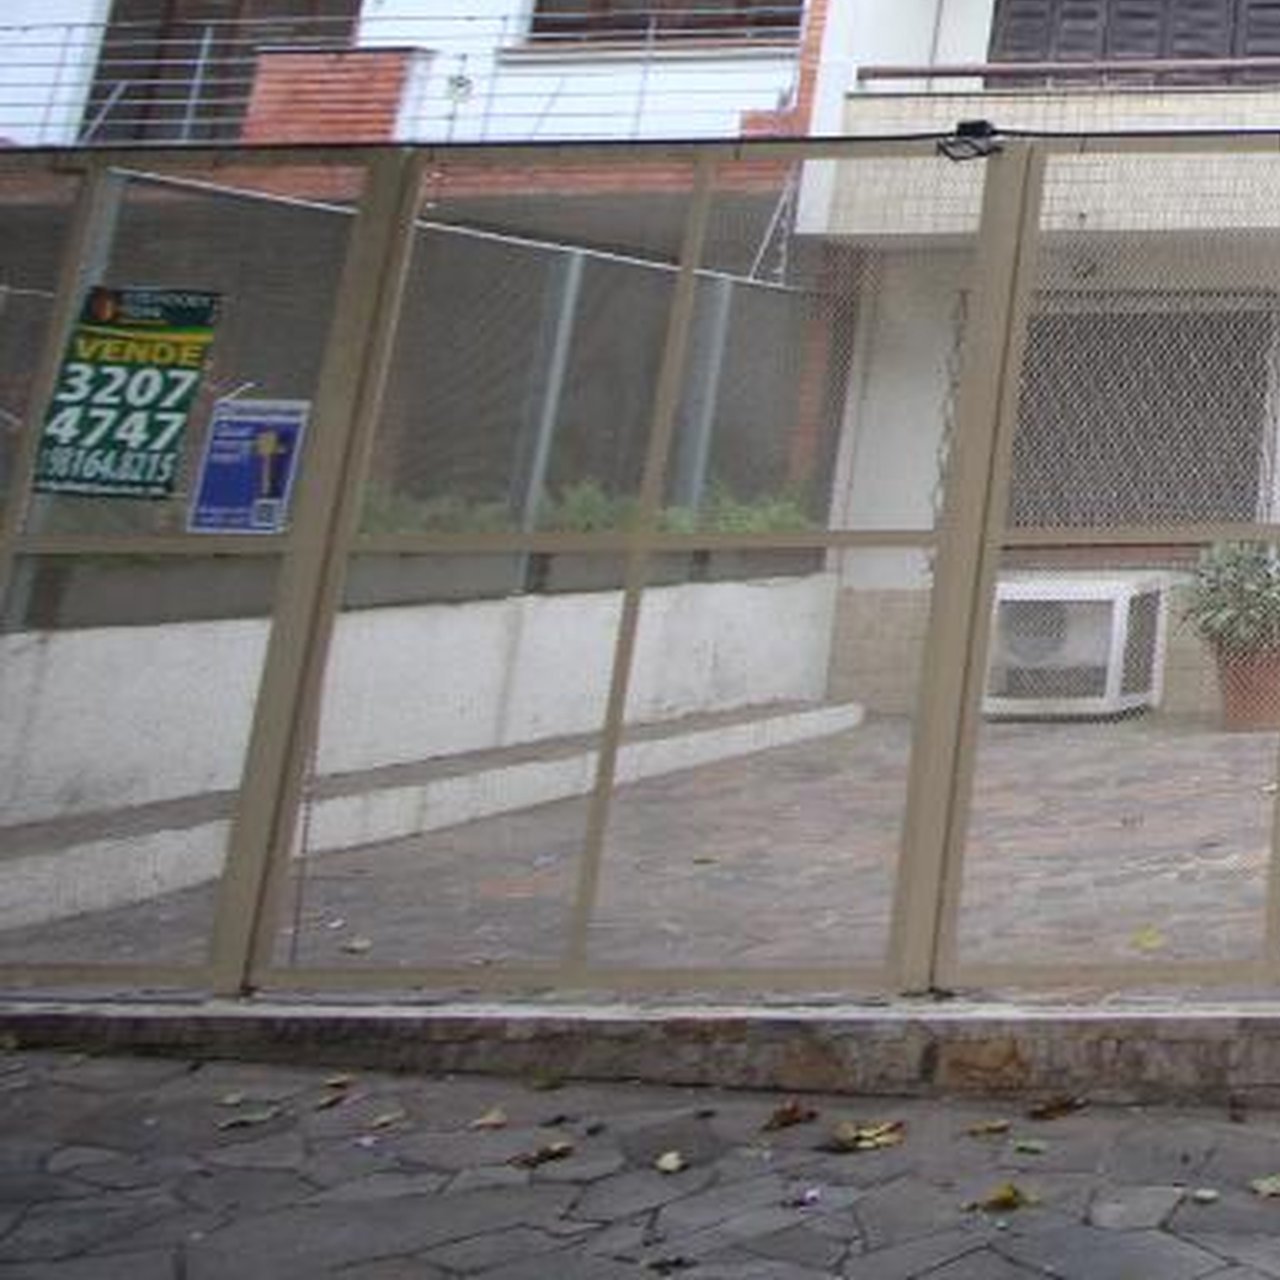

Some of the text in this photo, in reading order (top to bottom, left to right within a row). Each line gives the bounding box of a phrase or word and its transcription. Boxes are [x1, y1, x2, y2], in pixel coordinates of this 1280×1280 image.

[76, 338, 204, 366] VENDE
[55, 362, 199, 408] 3207
[45, 406, 187, 450] 4747
